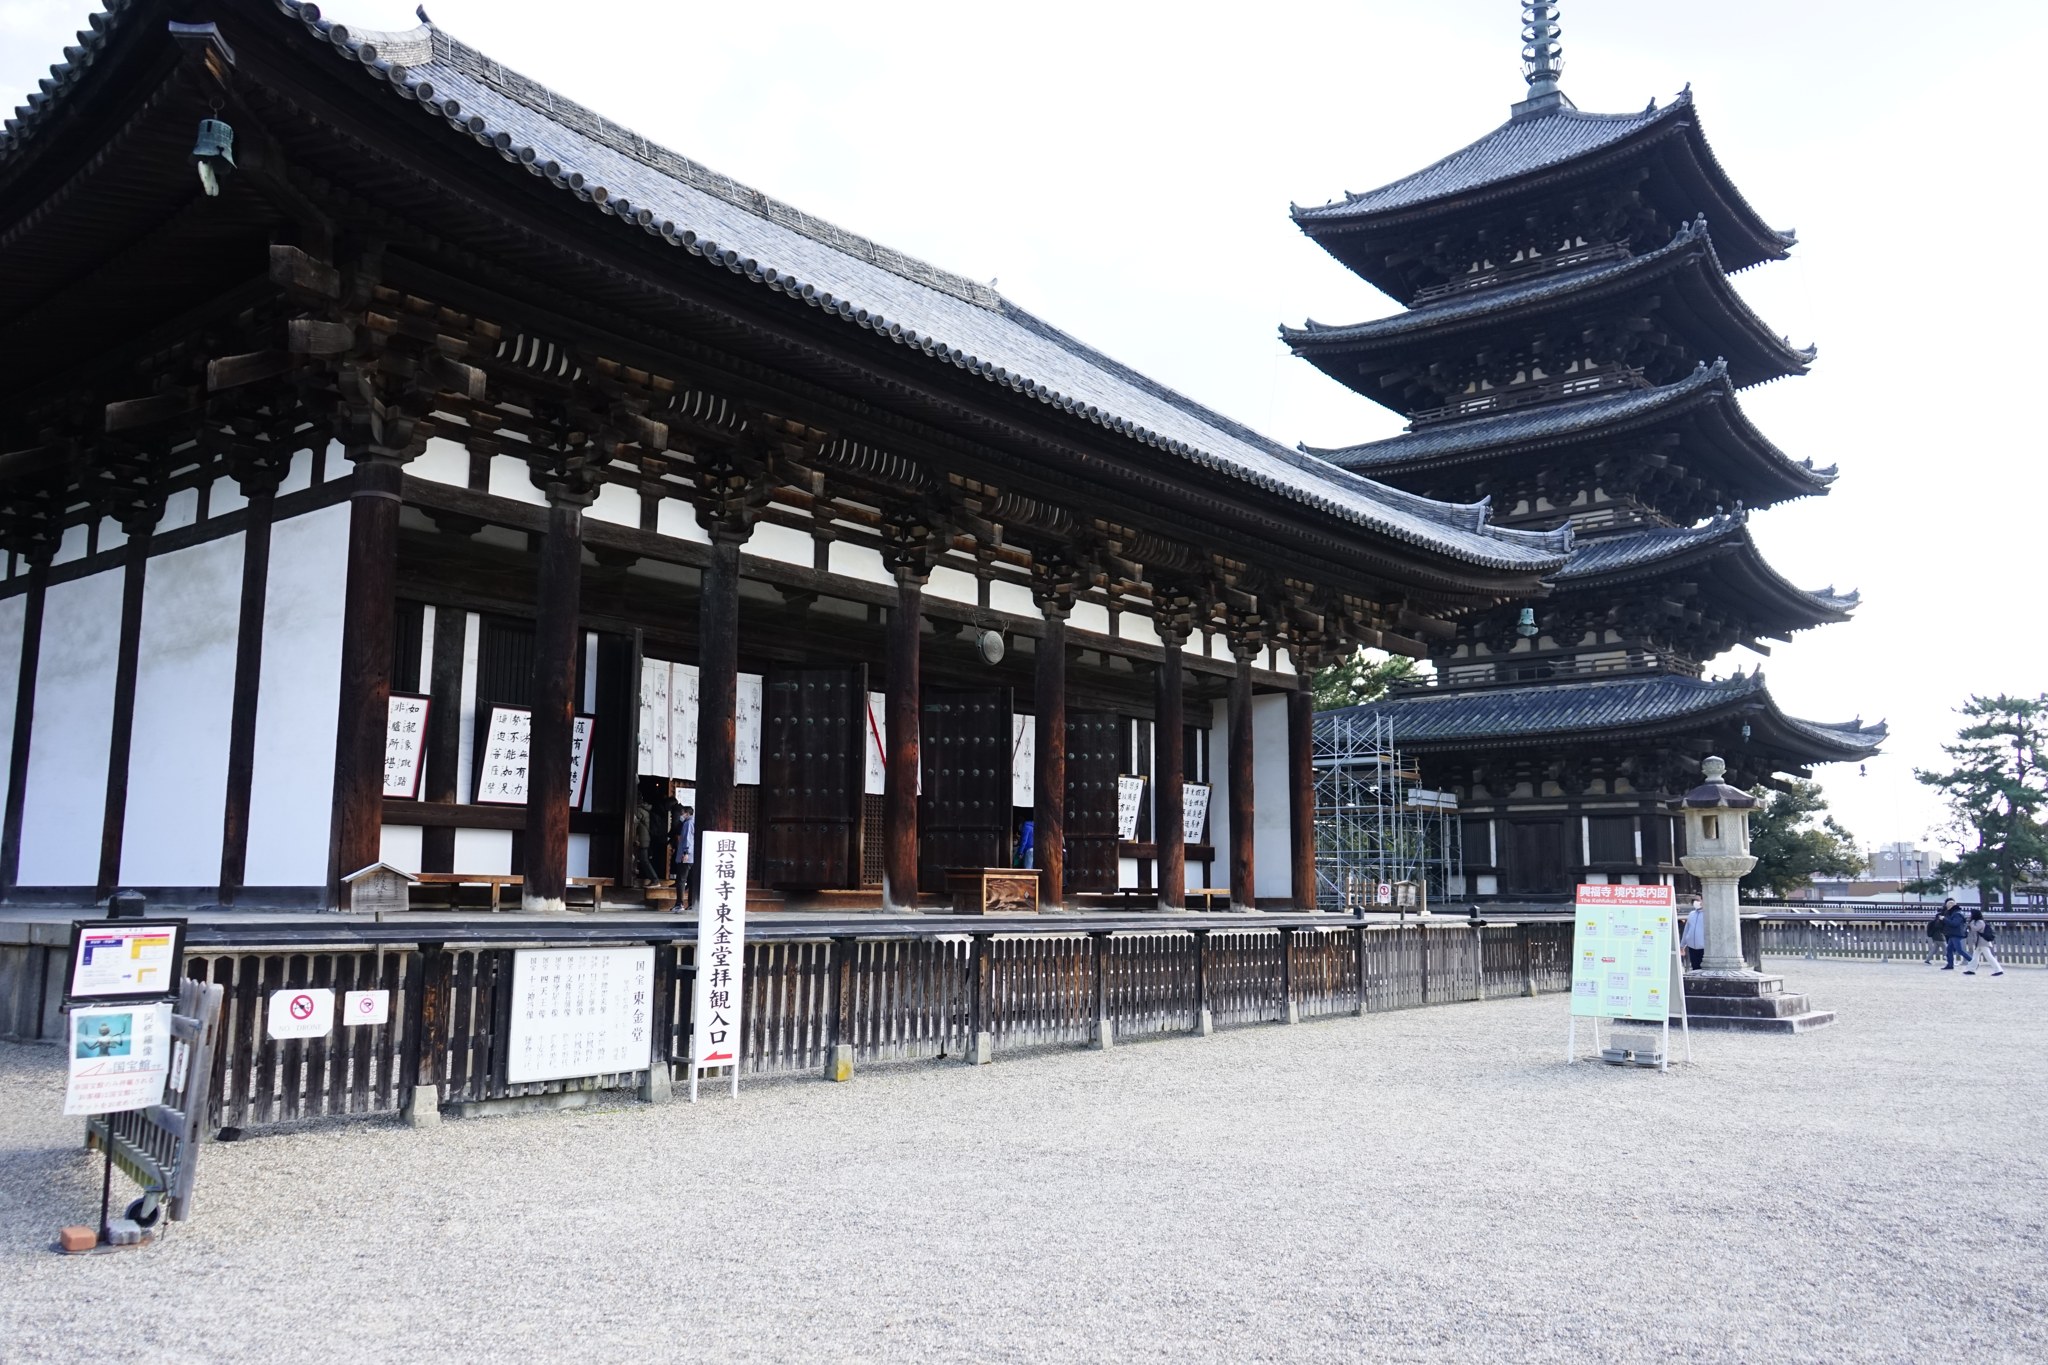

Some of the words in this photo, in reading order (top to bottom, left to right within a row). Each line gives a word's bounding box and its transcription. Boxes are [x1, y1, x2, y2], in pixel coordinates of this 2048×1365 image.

[1580, 886, 1611, 897] 興福寺
[1614, 887, 1668, 898] 境内案内図
[709, 838, 737, 1045] 興福寺東金堂拝観入口
[635, 960, 646, 986] 国宝
[296, 1024, 322, 1032] DRONE
[631, 991, 646, 1042] 東金堂
[142, 1012, 154, 1057] 阿修羅像
